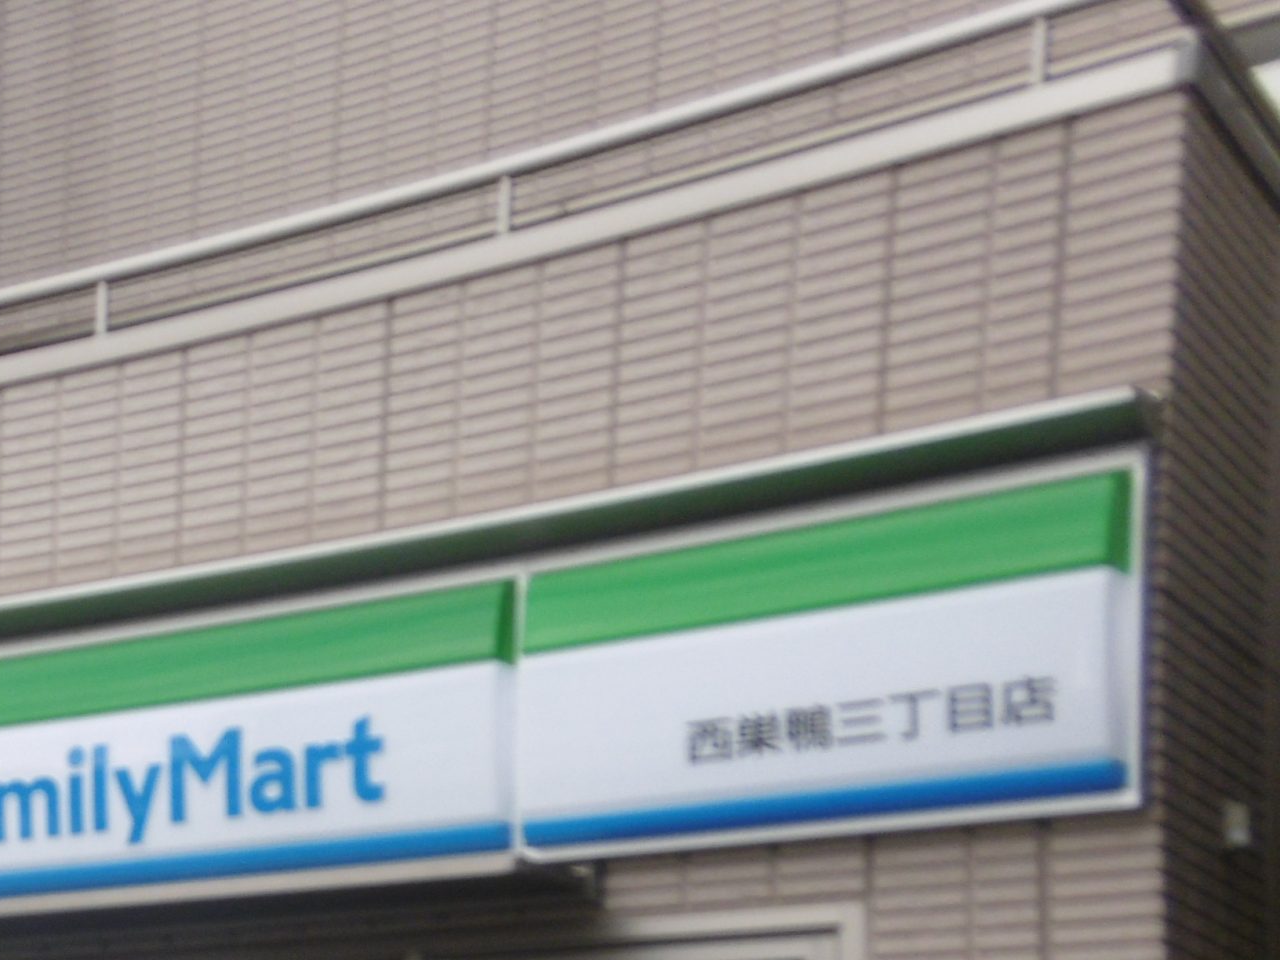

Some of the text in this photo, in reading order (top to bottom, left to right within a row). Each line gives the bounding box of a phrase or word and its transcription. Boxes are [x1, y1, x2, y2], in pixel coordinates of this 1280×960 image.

[686, 676, 1056, 764] 西巣鴨三丁目店
